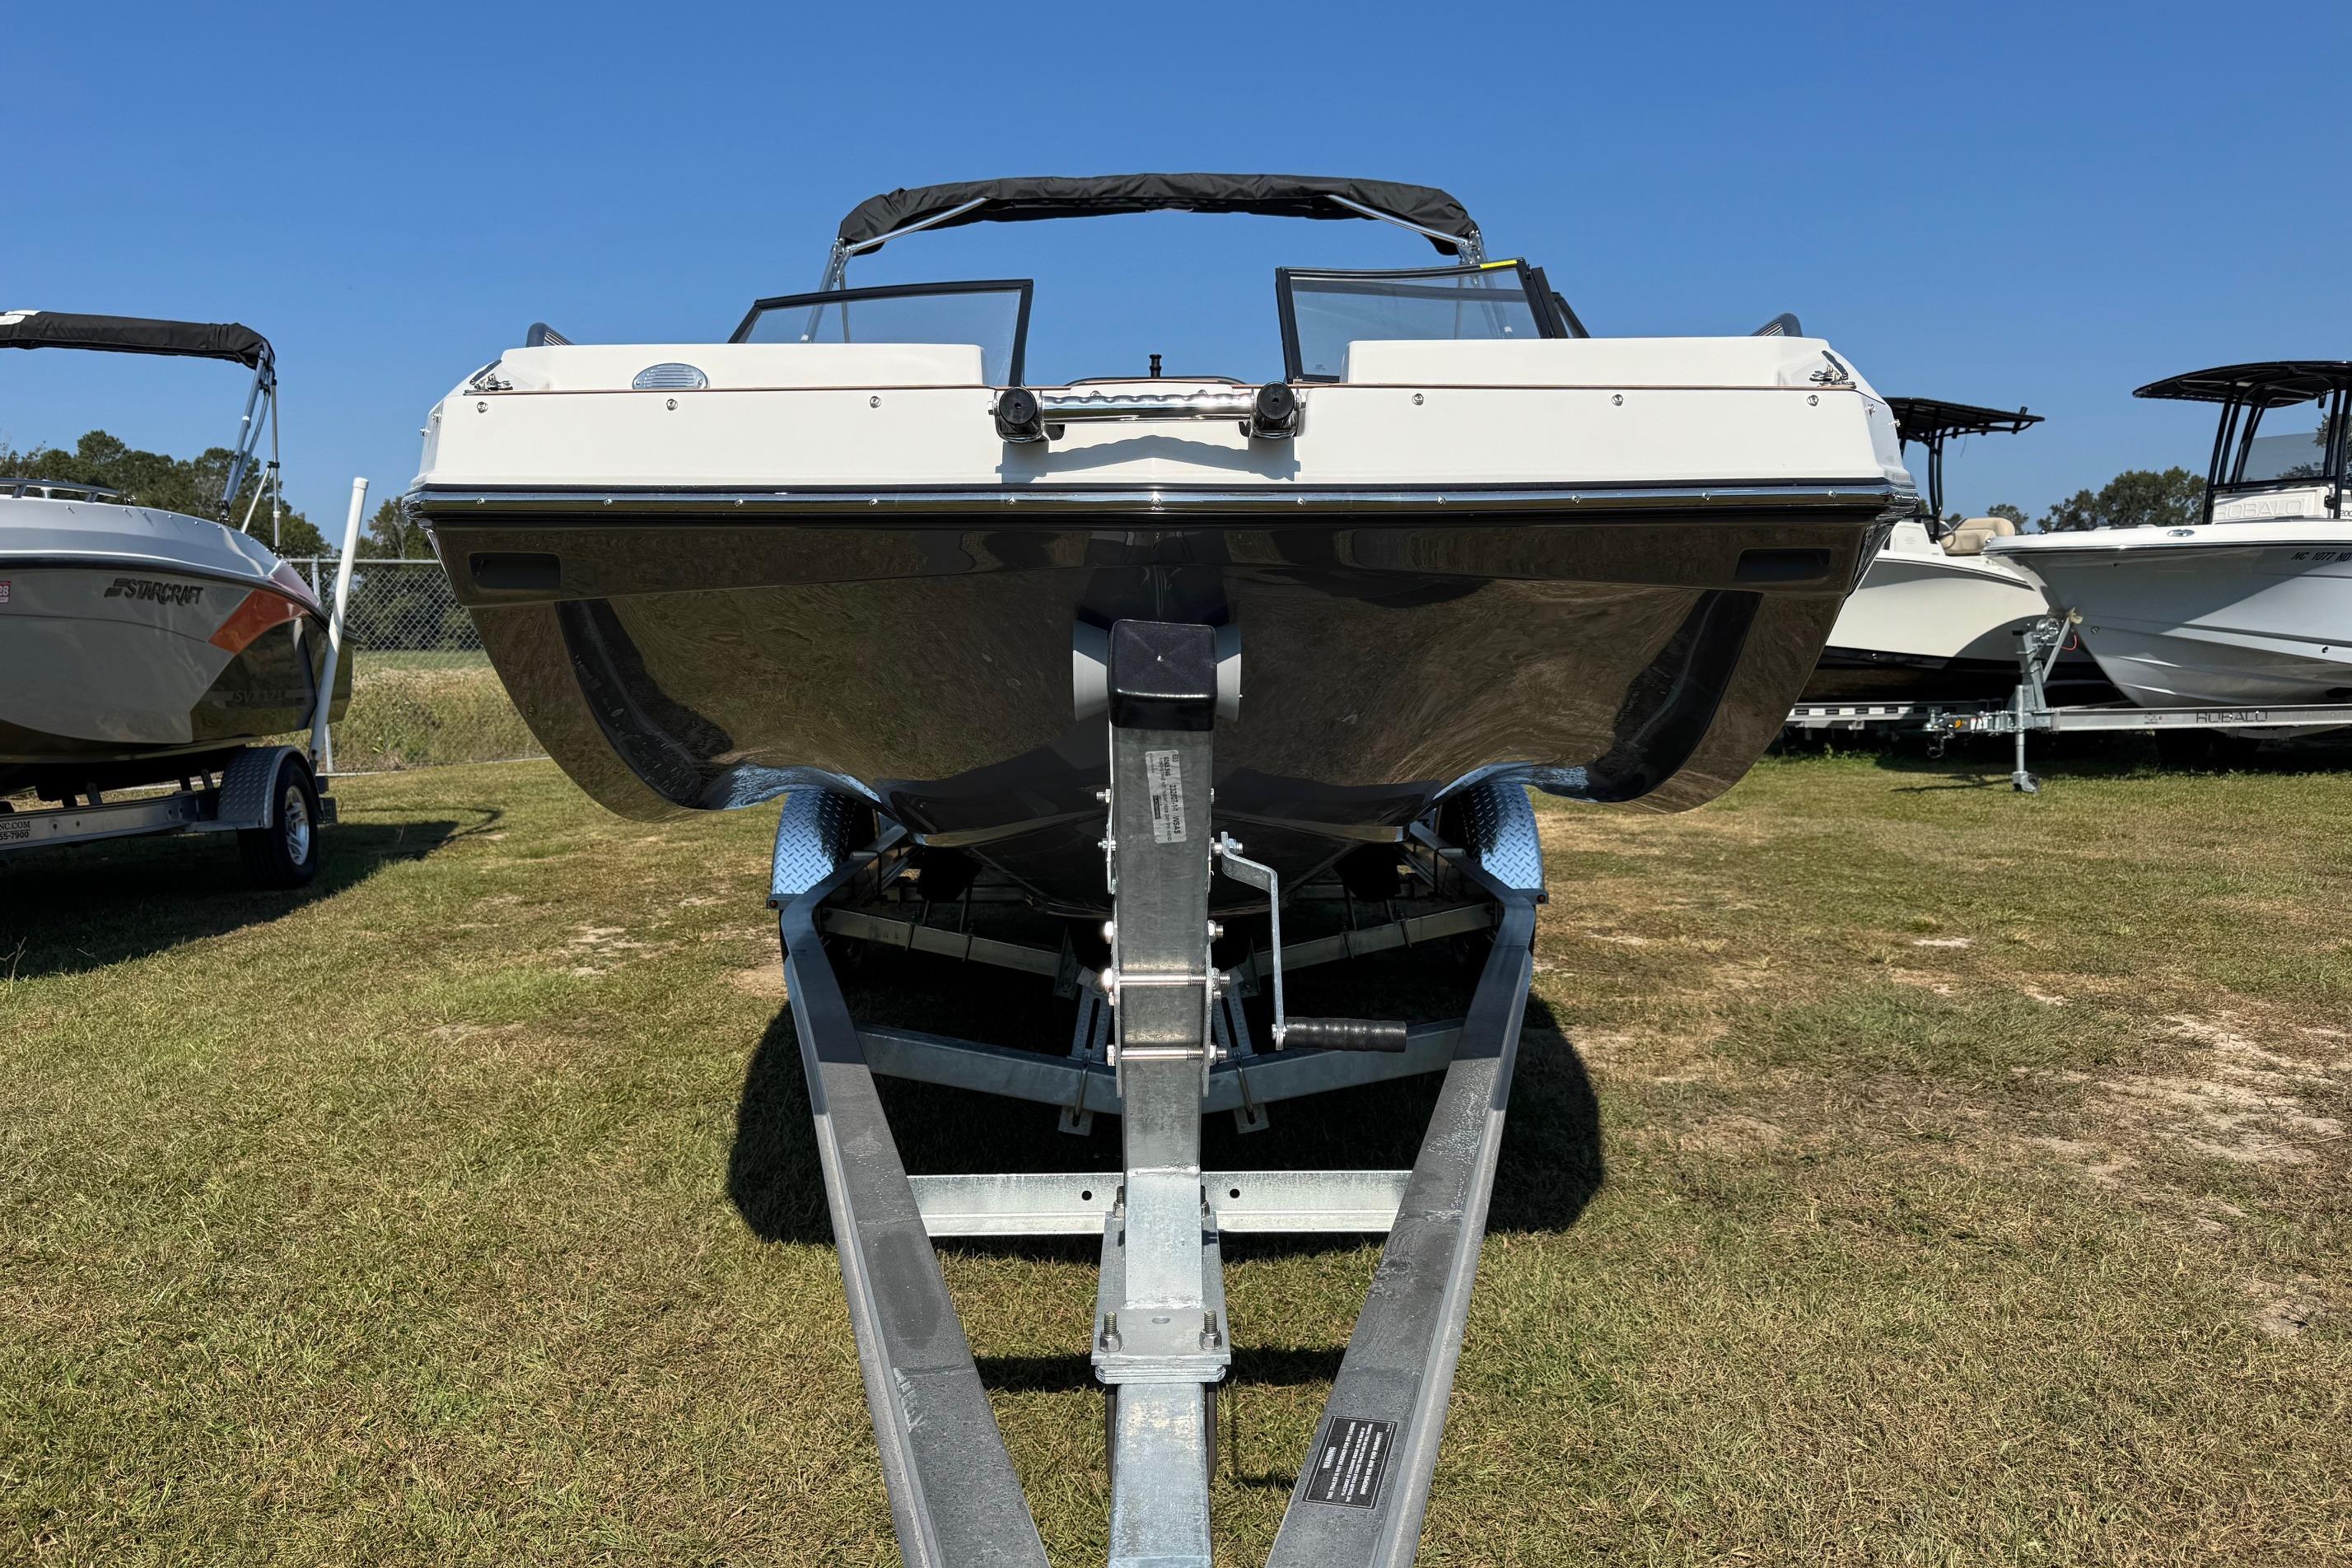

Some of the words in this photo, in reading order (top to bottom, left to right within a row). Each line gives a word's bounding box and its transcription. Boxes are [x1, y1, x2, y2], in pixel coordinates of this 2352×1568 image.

[2215, 499, 2303, 520] ROBALO
[2291, 551, 2310, 561] NC
[2312, 551, 2337, 561] 1077
[124, 578, 203, 606] STARCRAFT
[2196, 711, 2268, 723] ROBALO
[1322, 1447, 1337, 1468] WARNING
[1337, 1449, 1347, 1465] DESIGNED
[1370, 1451, 1378, 1459] VOID
[1367, 1459, 1375, 1468] MAY
[1329, 1477, 1339, 1491] TRAILER
[1341, 1478, 1351, 1496] PLACEMENT
[1347, 1484, 1356, 1496] TRAILER
[1360, 1476, 1371, 1495] IMPROPER
[1326, 1491, 1334, 1500] THIS
